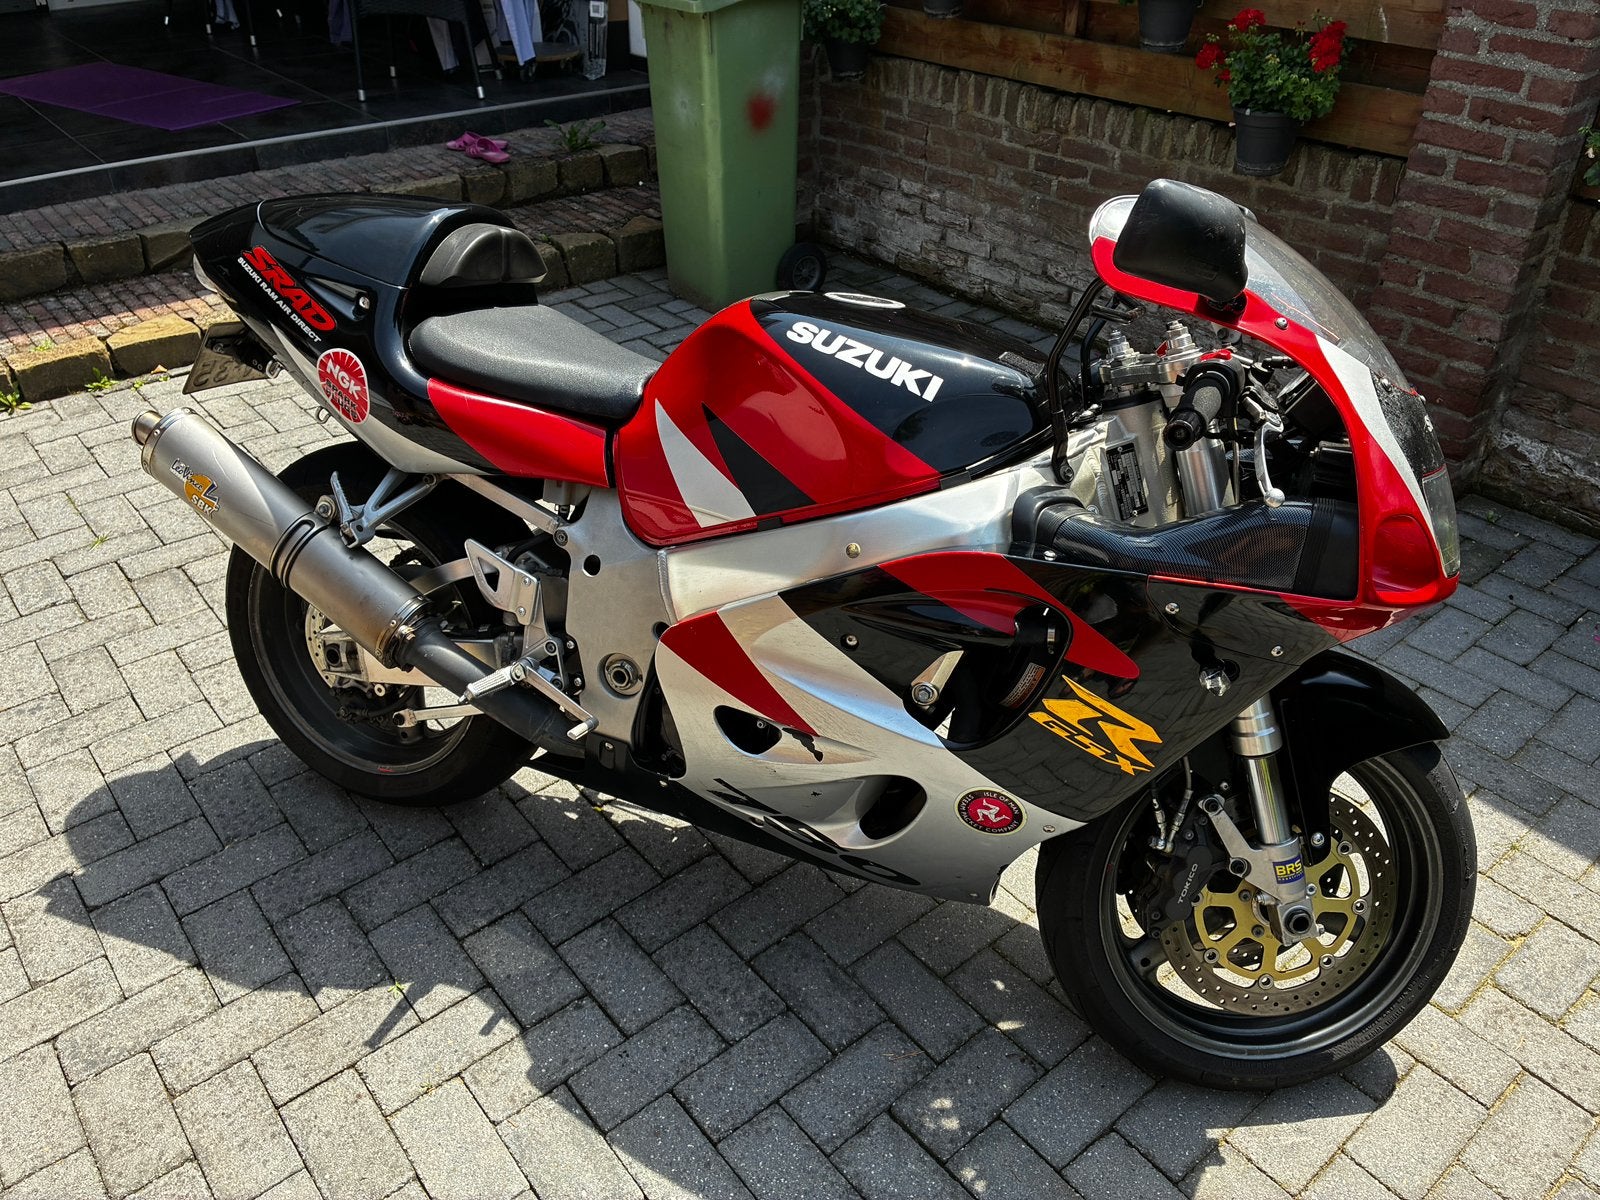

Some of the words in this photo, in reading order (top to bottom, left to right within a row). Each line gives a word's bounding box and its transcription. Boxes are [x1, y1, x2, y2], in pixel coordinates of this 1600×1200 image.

[237, 256, 262, 284] SUZUKI
[260, 281, 279, 301] RAM
[276, 300, 292, 316] AIR
[290, 313, 322, 343] DIRECT
[241, 245, 337, 332] SRAD
[326, 358, 362, 400] NGK
[785, 321, 944, 403] SUZUKI
[1028, 711, 1151, 776] GSX
[960, 794, 975, 811] STEAM
[961, 811, 983, 830] PACKET
[998, 795, 1009, 803] OF
[1008, 802, 1020, 815] MAN
[985, 820, 1020, 833] COMPANY
[1177, 863, 1199, 904] TOKICO
[1275, 859, 1303, 877] BRS
